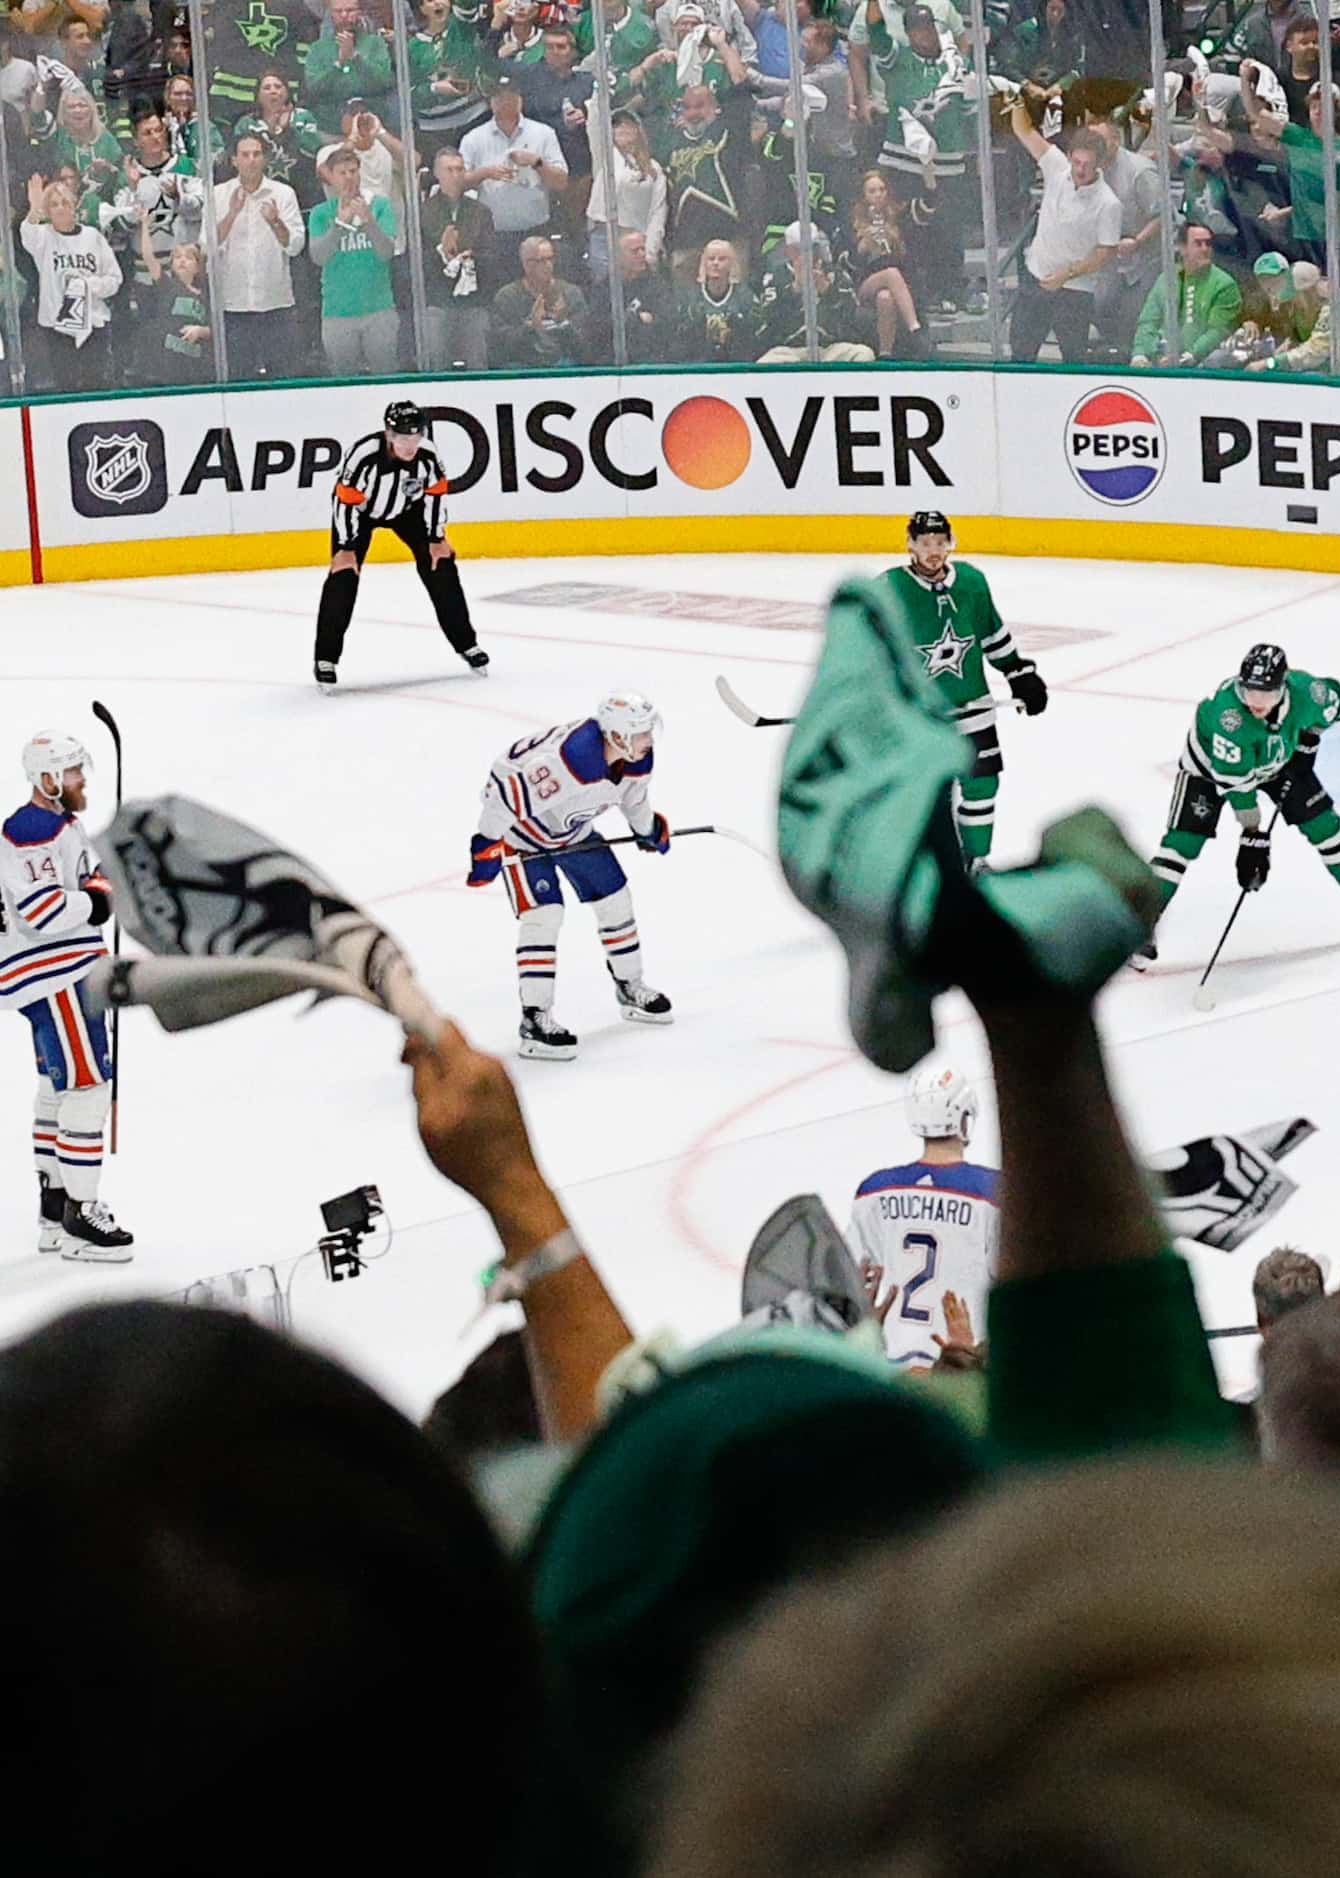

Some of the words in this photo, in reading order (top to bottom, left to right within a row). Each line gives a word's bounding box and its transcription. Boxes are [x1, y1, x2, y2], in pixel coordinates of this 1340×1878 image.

[340, 230, 373, 252] TAR
[1072, 432, 1159, 460] PEPSI
[100, 449, 138, 489] NHL
[1212, 732, 1242, 764] 53
[528, 765, 561, 800] 93
[24, 856, 57, 883] 14
[880, 1195, 972, 1226] BOUCHARD
[900, 1230, 938, 1325] 2
